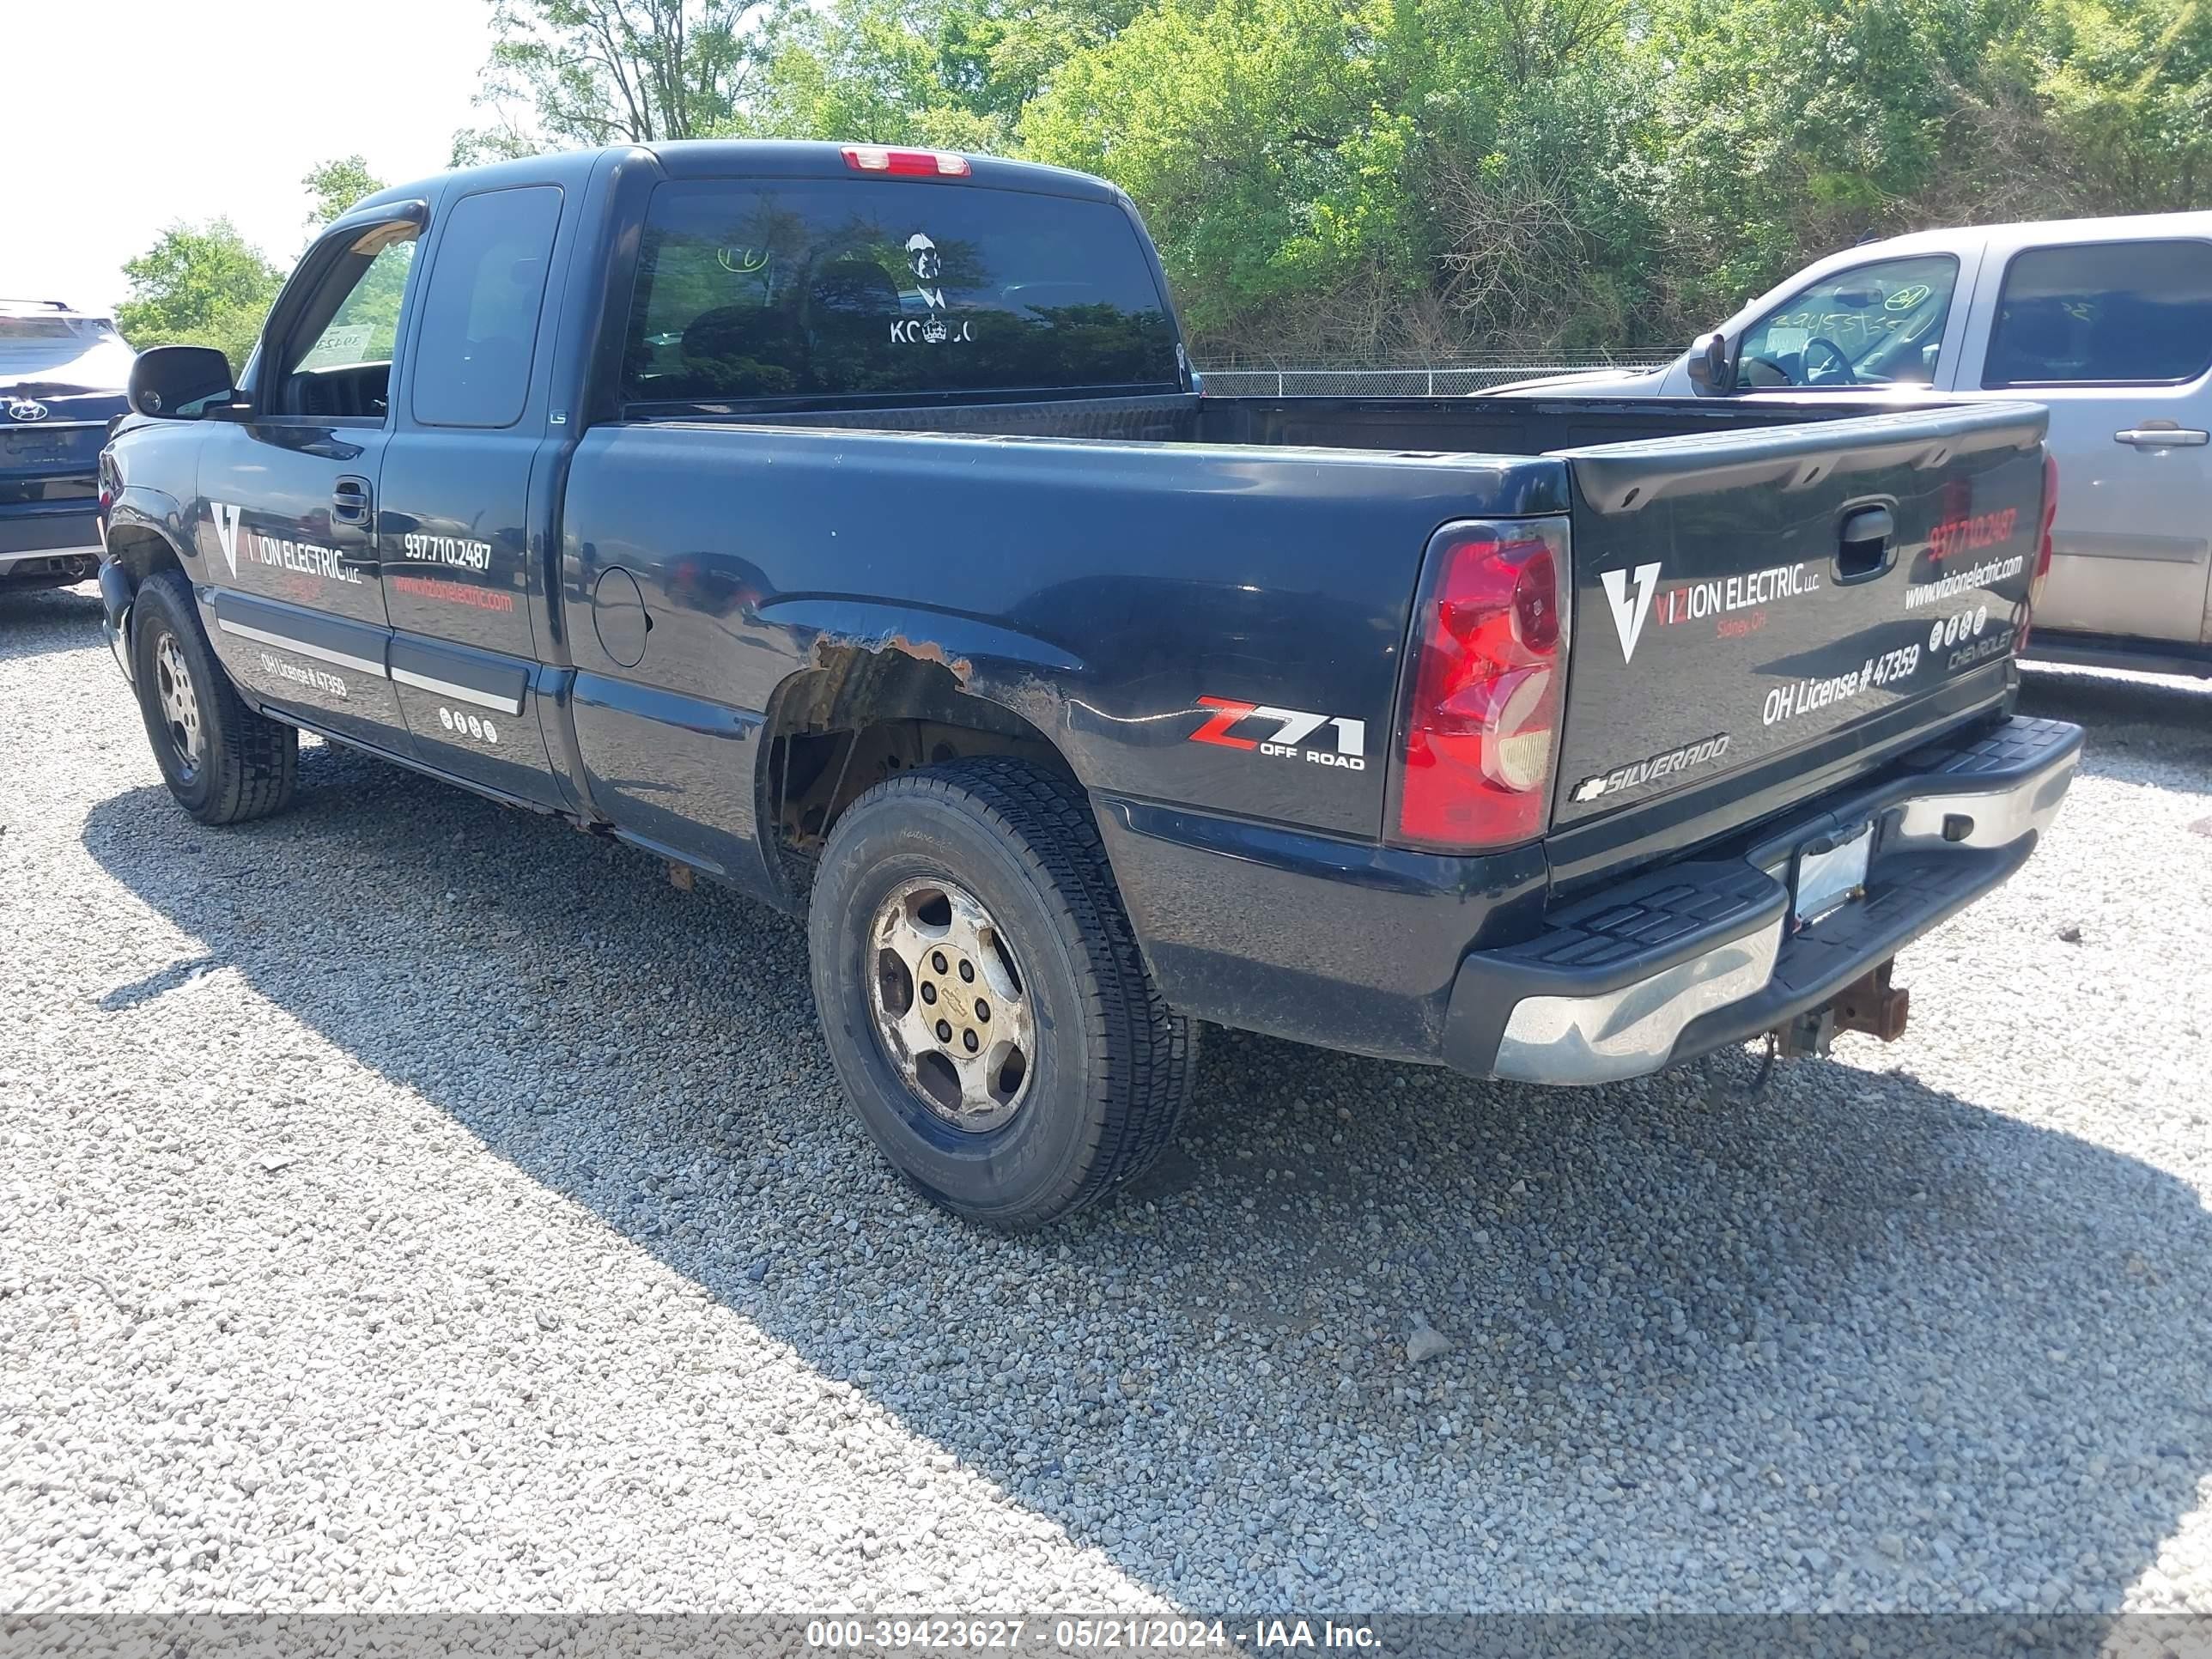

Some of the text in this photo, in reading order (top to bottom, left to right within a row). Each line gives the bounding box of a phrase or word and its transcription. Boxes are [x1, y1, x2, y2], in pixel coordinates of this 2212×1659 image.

[237, 532, 283, 568] IION
[283, 539, 345, 581] ELECTRIC
[404, 533, 491, 570] 937.710.2487
[1928, 508, 2016, 562] 937.710.2487
[1655, 580, 1722, 626] VIZION
[1726, 562, 1804, 611] ELECTRIC
[1905, 555, 2023, 610] www.vizionelectric.com
[261, 653, 277, 674] OH
[274, 658, 310, 685] License
[316, 671, 347, 697] 47359
[1948, 629, 2014, 670] CHEVROLET
[1763, 643, 1920, 726] OH License # 47359
[1188, 696, 1366, 757] Z71
[1260, 743, 1365, 771] OFF ROAD
[1604, 735, 1730, 795] SILVERADO
